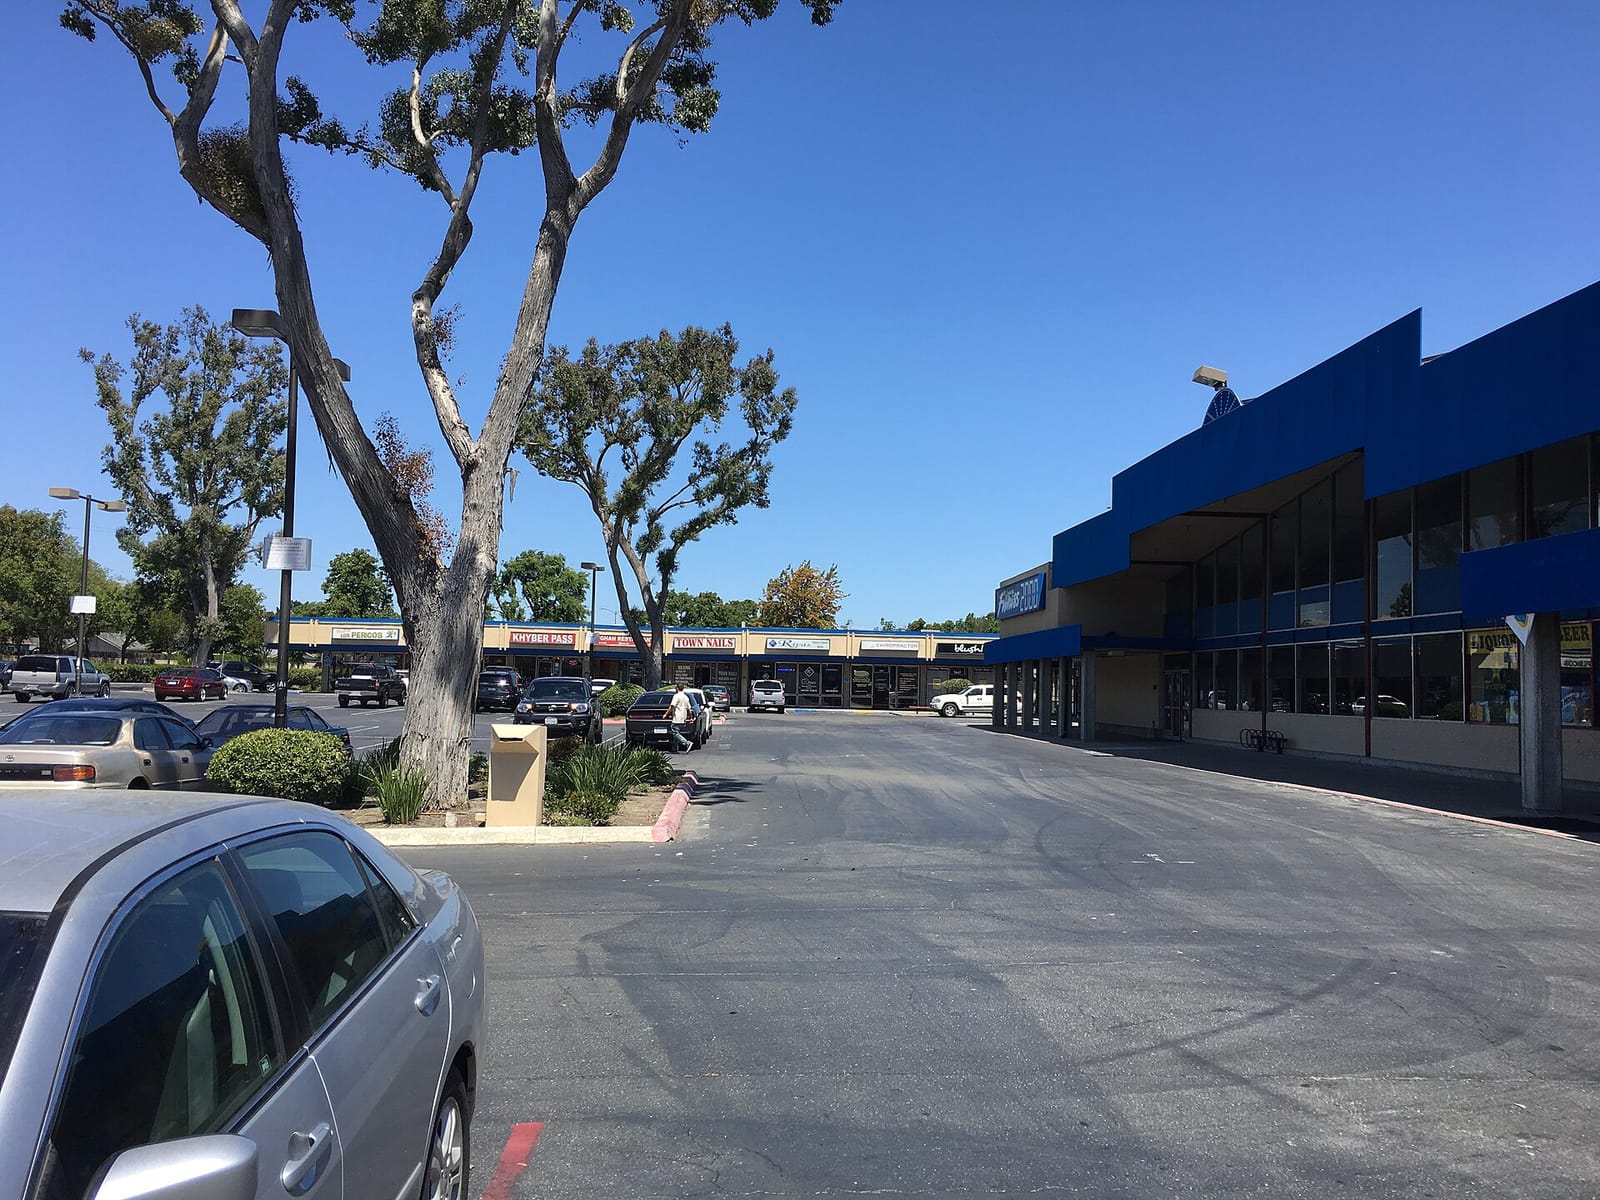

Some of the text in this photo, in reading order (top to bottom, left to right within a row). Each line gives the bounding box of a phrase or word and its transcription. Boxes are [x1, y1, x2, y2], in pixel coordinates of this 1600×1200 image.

[1019, 578, 1039, 612] 2000
[512, 632, 573, 644] KHYBER PASS
[676, 638, 733, 648] TOWN NAILS
